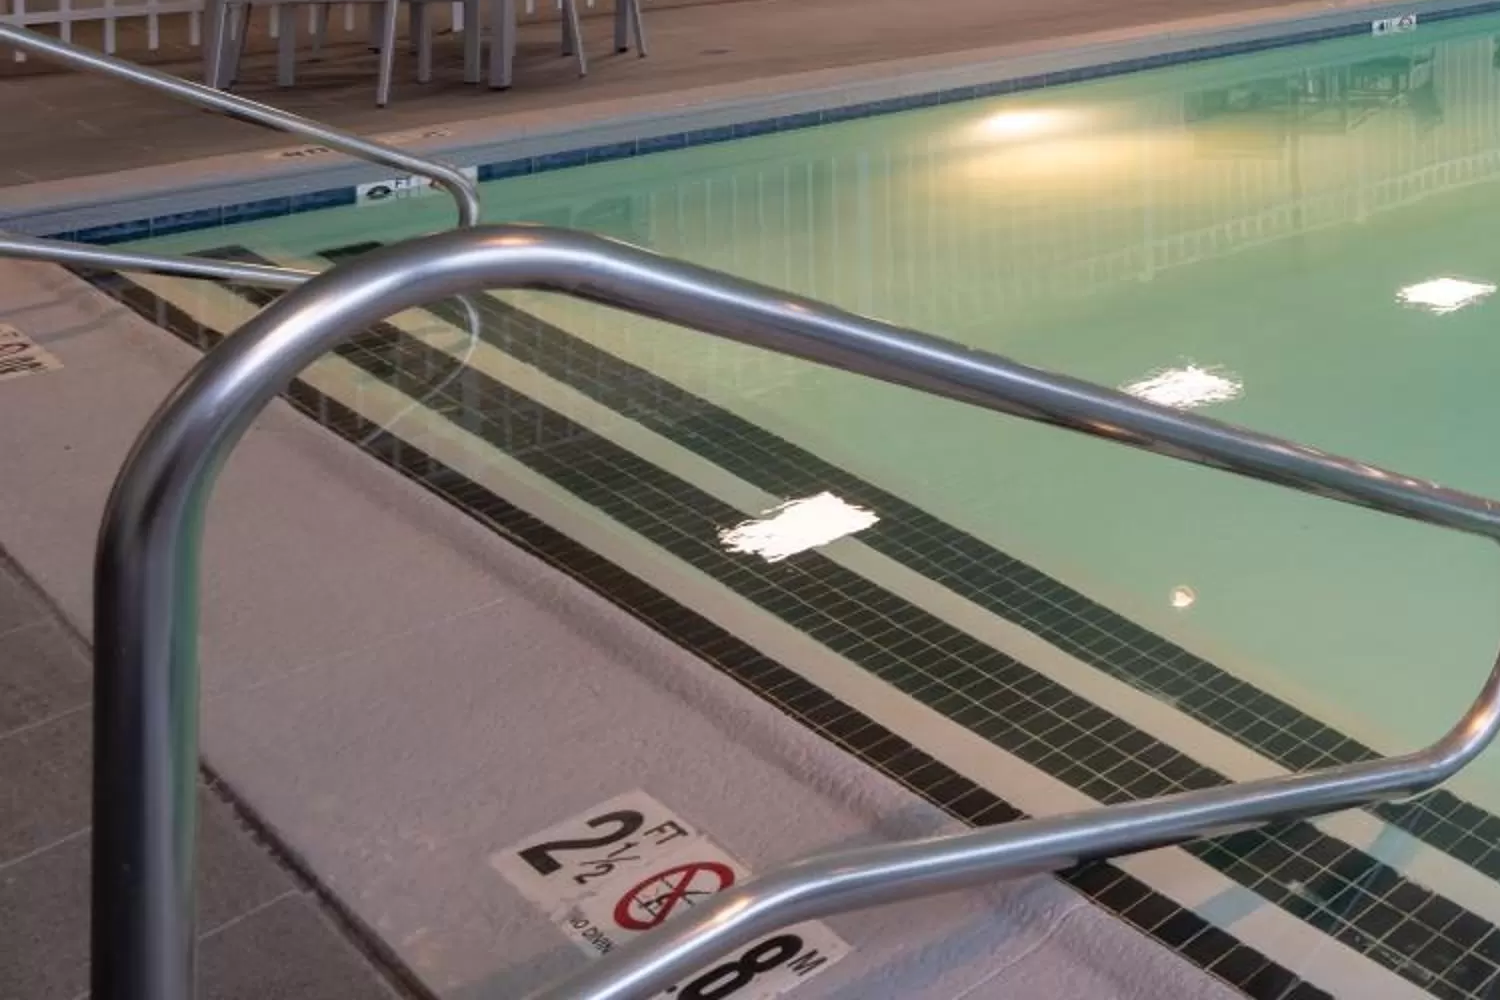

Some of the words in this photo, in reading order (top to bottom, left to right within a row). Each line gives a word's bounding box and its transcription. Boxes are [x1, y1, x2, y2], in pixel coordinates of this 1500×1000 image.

[518, 809, 644, 876] 2
[643, 821, 689, 845] FT
[787, 949, 828, 976] M
